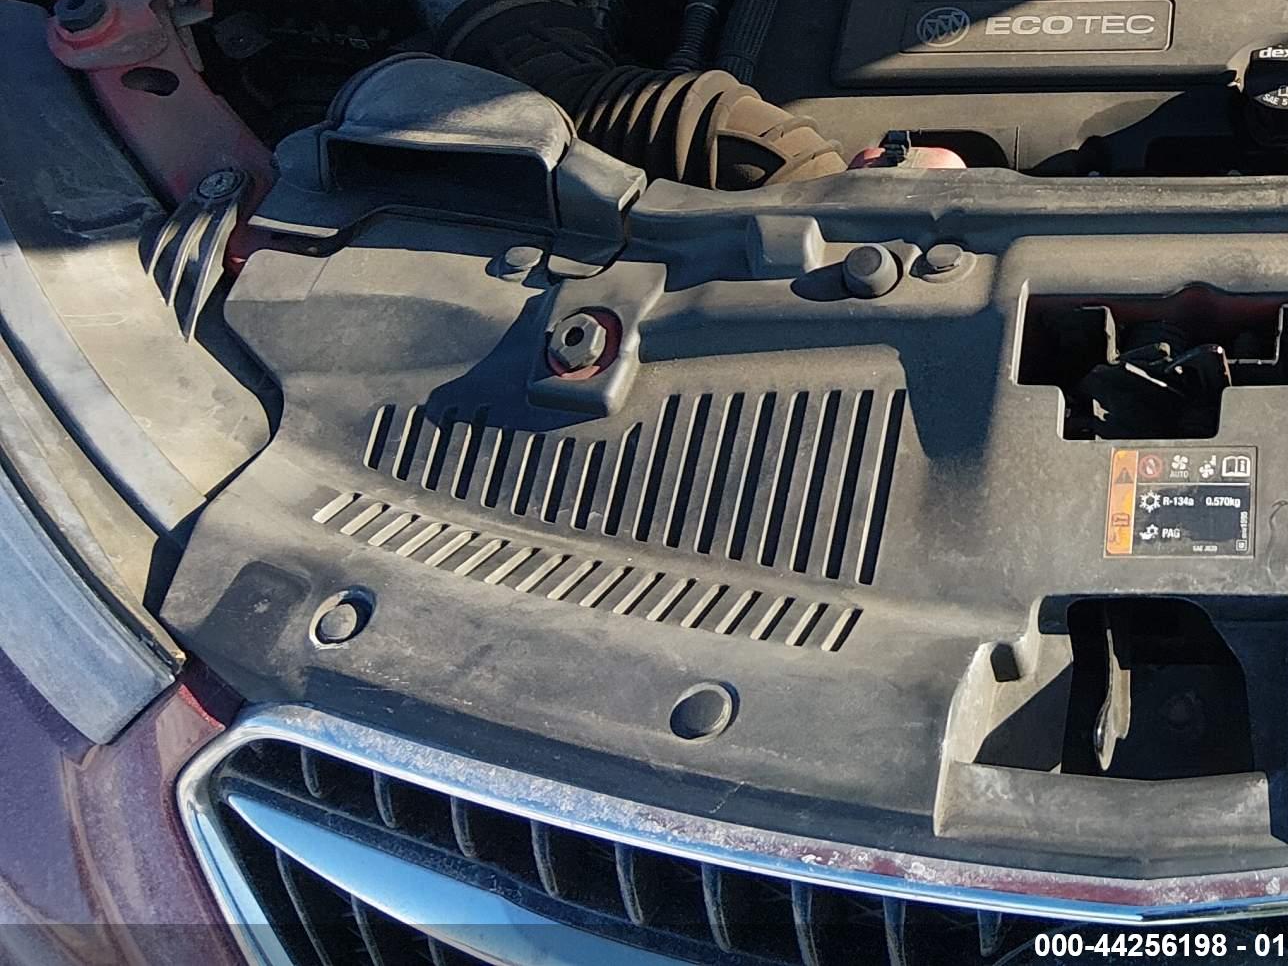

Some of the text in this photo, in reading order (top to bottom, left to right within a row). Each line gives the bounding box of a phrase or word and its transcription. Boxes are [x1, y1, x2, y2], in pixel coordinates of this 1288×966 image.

[984, 14, 1156, 36] ECOTEC
[1262, 93, 1280, 106] SAE
[1169, 470, 1190, 479] AUTO
[1162, 496, 1241, 508] R-134a 0.570kg
[1161, 528, 1181, 539] PAG
